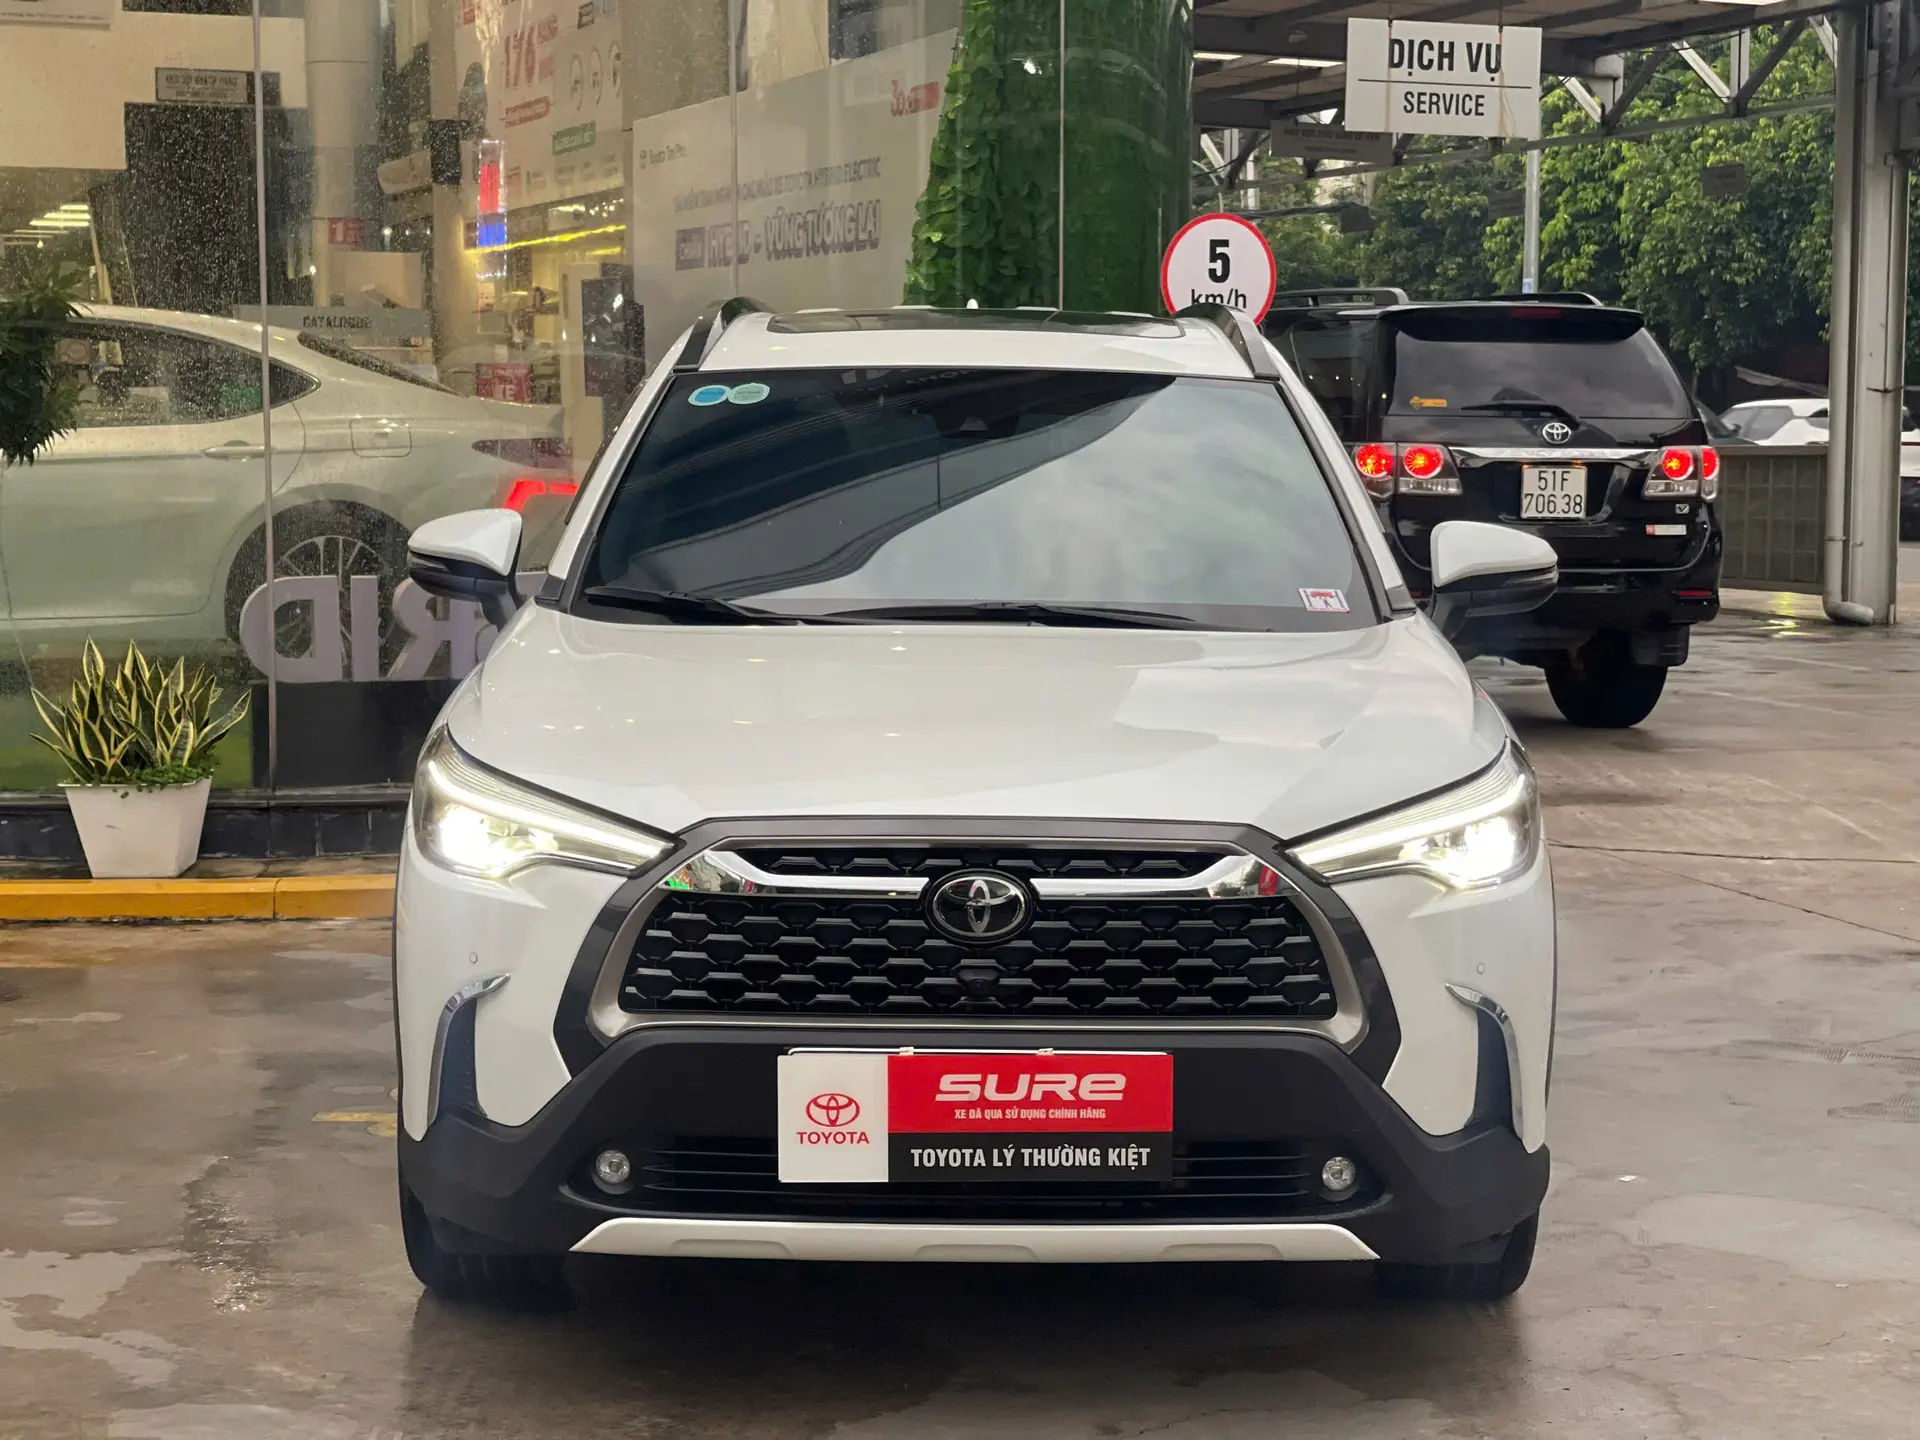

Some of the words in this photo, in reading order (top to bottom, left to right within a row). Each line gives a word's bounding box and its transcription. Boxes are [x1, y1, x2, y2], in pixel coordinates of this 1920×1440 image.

[1388, 38, 1455, 76] DỊCH
[1466, 42, 1502, 82] VỤ
[1403, 91, 1485, 116] SERVICE
[1208, 239, 1230, 283] 5
[1191, 288, 1247, 309] km/h
[1538, 470, 1571, 491] 51F
[1524, 493, 1583, 515] 706.38
[954, 1109, 967, 1119] XE
[969, 1107, 983, 1119] ĐÃ
[985, 1109, 1003, 1120] QUA
[1005, 1106, 1018, 1119] SỬ
[1020, 1109, 1046, 1121] DỤNG
[1048, 1107, 1078, 1119] CHÍNH
[1080, 1107, 1106, 1119] HÃNG
[797, 1131, 870, 1144] TOYOTA
[911, 1149, 986, 1167] TOYOTA
[992, 1144, 1016, 1167] LÝ
[1020, 1144, 1101, 1167] THƯỜNG
[1107, 1143, 1150, 1171] KIỆT
